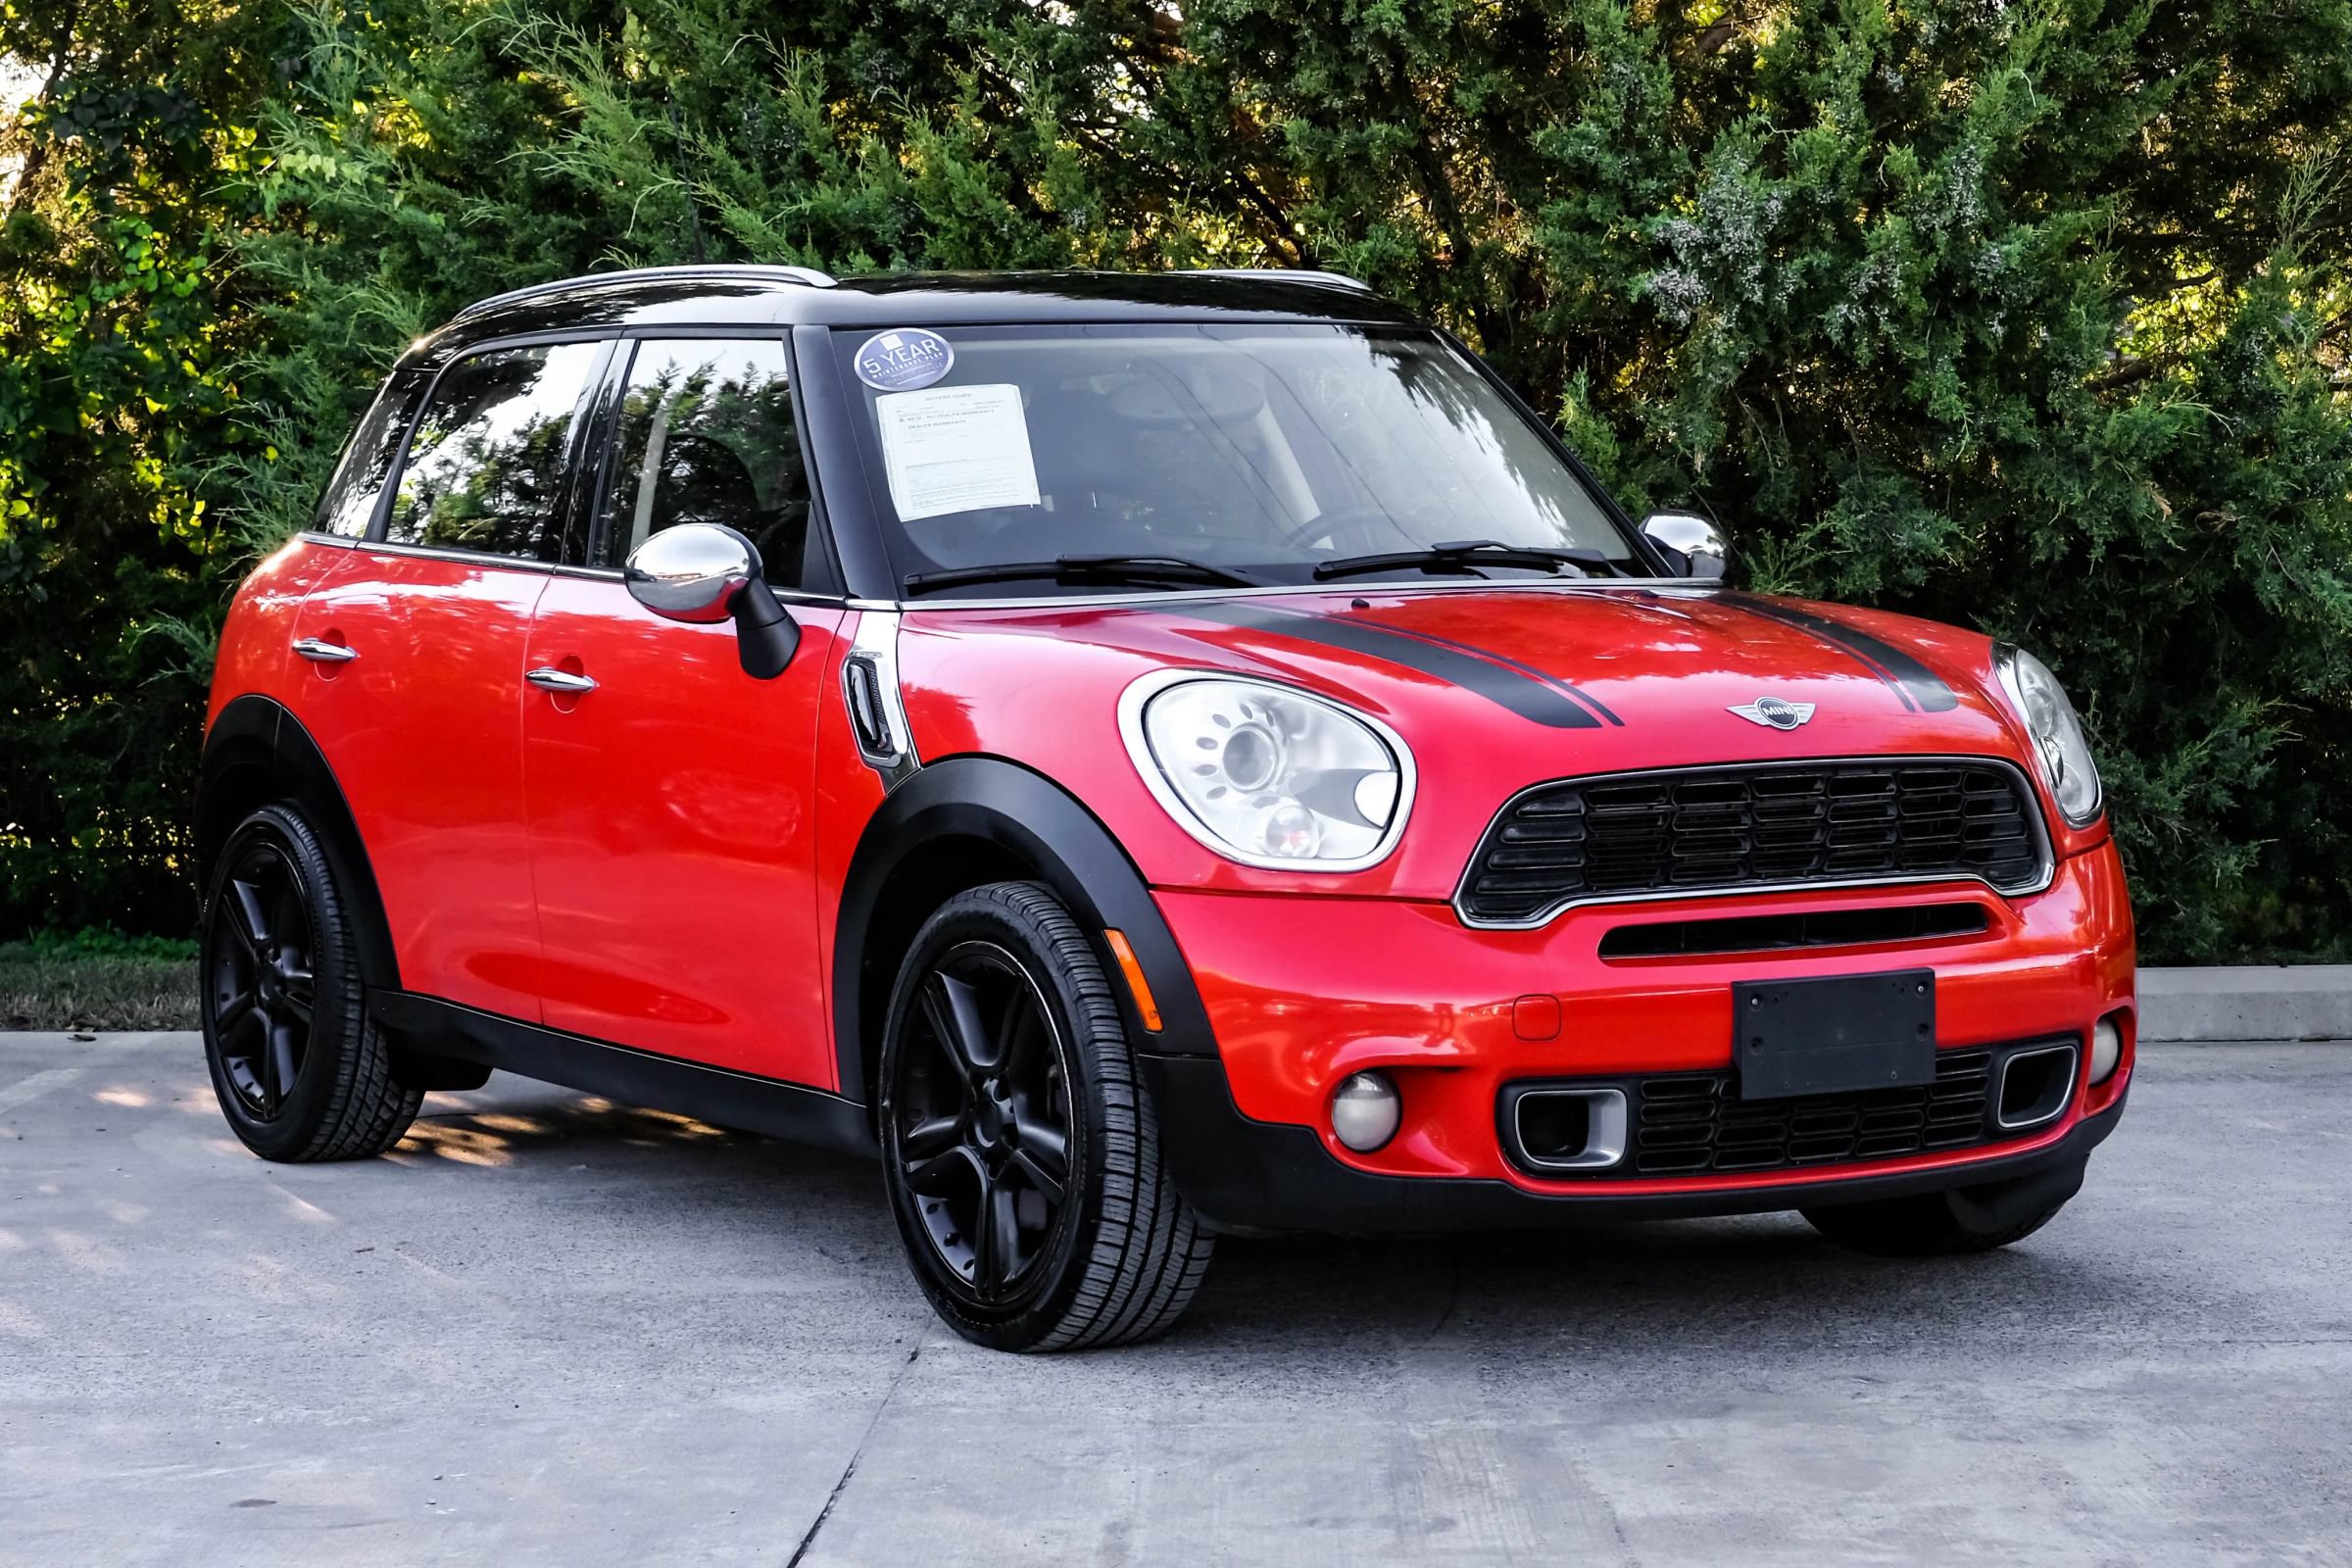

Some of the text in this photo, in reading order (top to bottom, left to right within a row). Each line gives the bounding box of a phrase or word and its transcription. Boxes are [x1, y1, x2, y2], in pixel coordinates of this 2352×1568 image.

[862, 358, 882, 374] 5
[880, 338, 940, 367] YEAR
[1761, 706, 1795, 716] MINI
